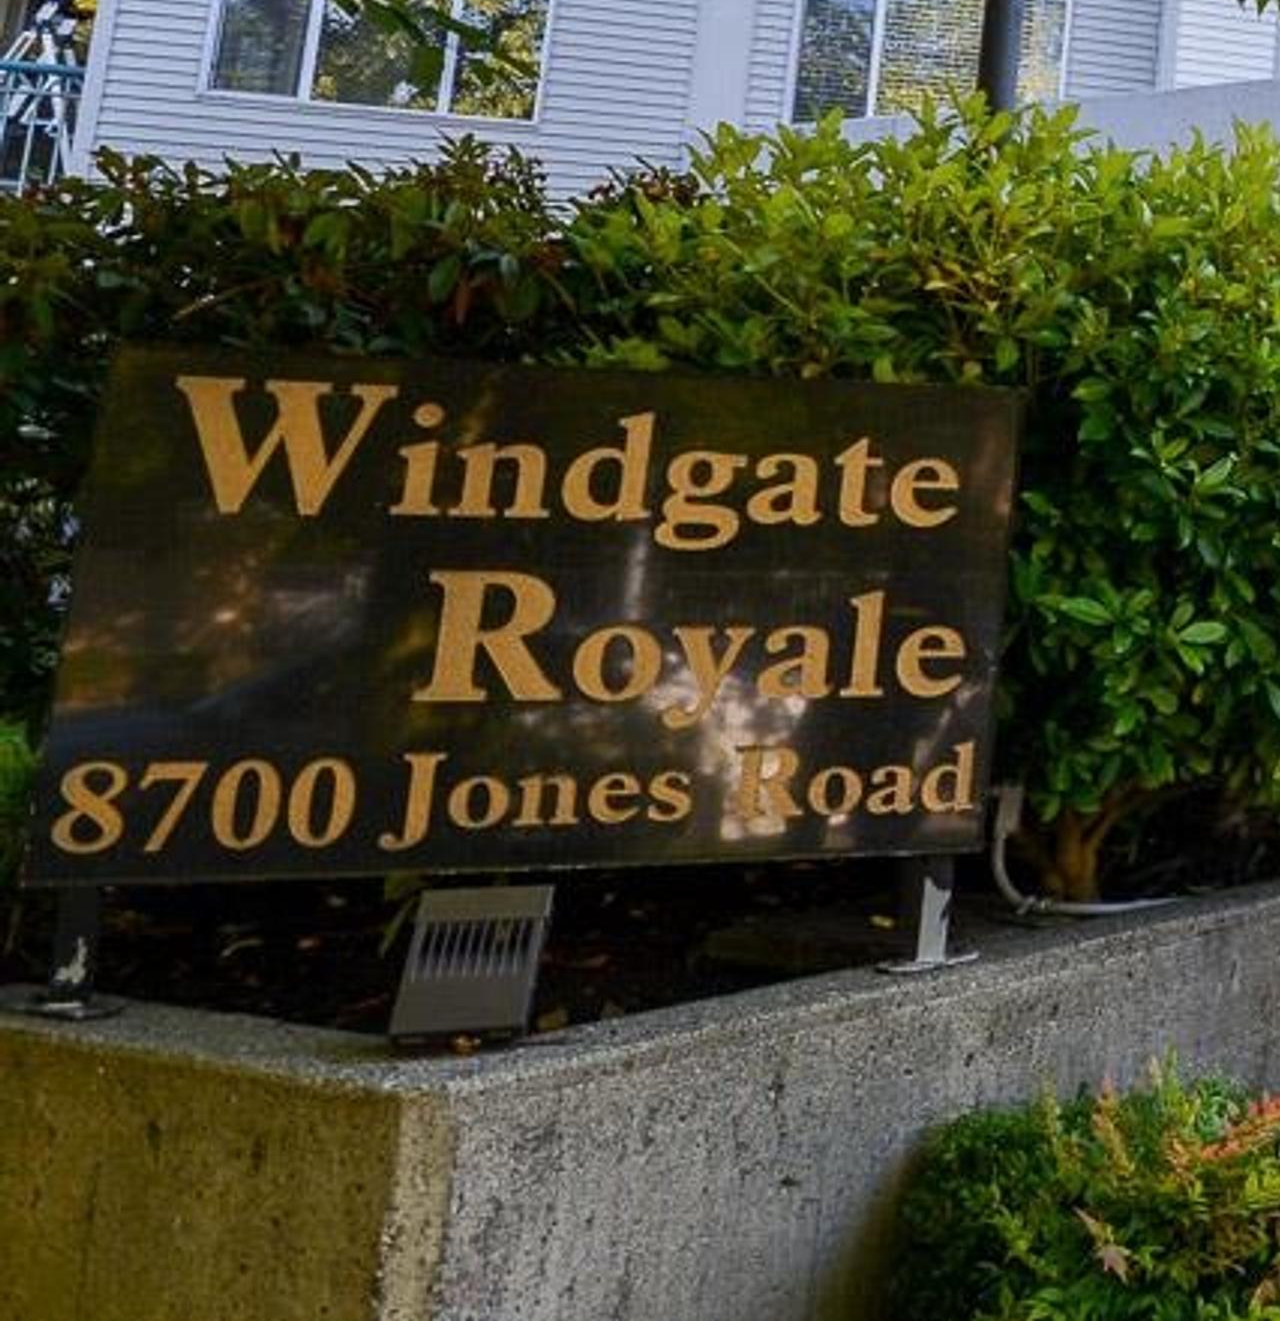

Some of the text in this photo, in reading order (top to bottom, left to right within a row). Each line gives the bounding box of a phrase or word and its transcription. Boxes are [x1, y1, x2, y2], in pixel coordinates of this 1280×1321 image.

[175, 375, 961, 552] Windgate
[412, 569, 967, 729] Royale
[49, 743, 977, 855] 8700 Jones Road
